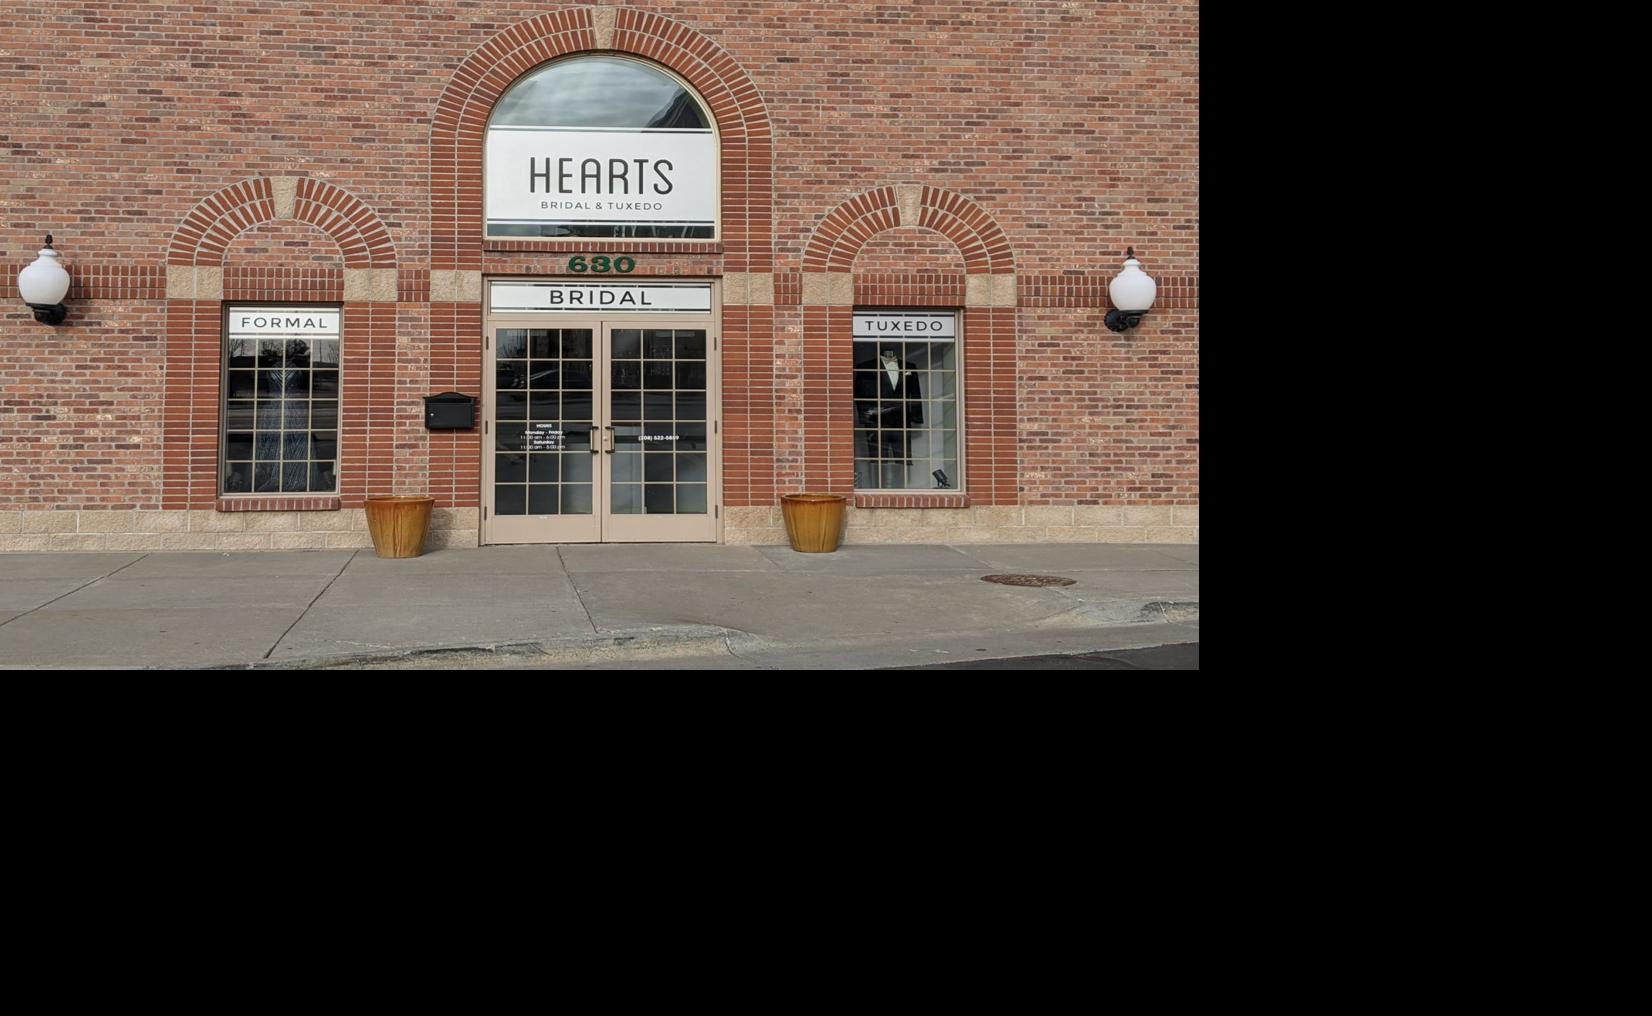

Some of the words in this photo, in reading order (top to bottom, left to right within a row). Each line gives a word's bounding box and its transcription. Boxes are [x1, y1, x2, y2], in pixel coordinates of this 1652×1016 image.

[530, 157, 673, 195] HEARTS
[541, 201, 591, 210] BRIDAL
[595, 202, 603, 210] &
[607, 202, 663, 211] TUXEDO
[568, 255, 635, 273] 630
[550, 290, 652, 305] BRIDAL
[241, 317, 328, 329] FORMAL
[864, 320, 943, 332] TUXEDO
